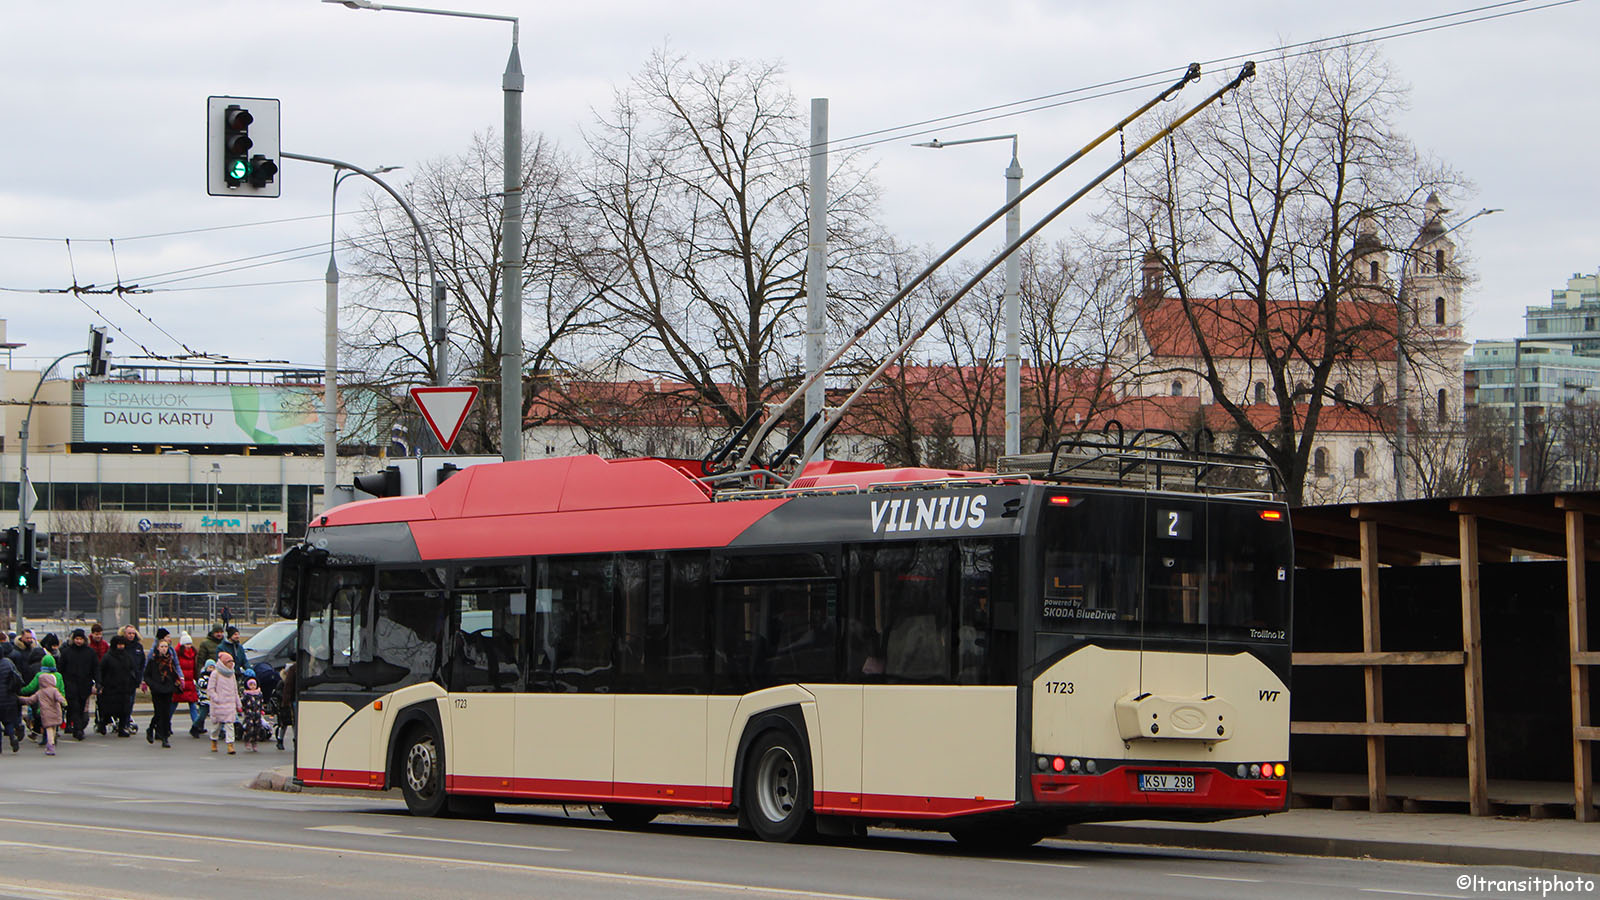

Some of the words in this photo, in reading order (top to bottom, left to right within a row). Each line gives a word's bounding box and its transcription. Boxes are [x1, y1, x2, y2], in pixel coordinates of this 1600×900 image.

[104, 390, 188, 406] IŠPAKUOK
[104, 411, 152, 424] DAUG
[159, 412, 213, 429] KARTŲ
[870, 494, 987, 533] VILNIUS
[1168, 511, 1178, 536] 2
[1044, 599, 1072, 607] powered
[1072, 600, 1082, 608] by
[1043, 607, 1074, 618] SKODA
[1076, 608, 1117, 620] BlueDrive
[1045, 681, 1074, 694] 1723
[454, 699, 467, 708] 1723
[1145, 775, 1167, 787] KSV
[1174, 776, 1193, 788] 298
